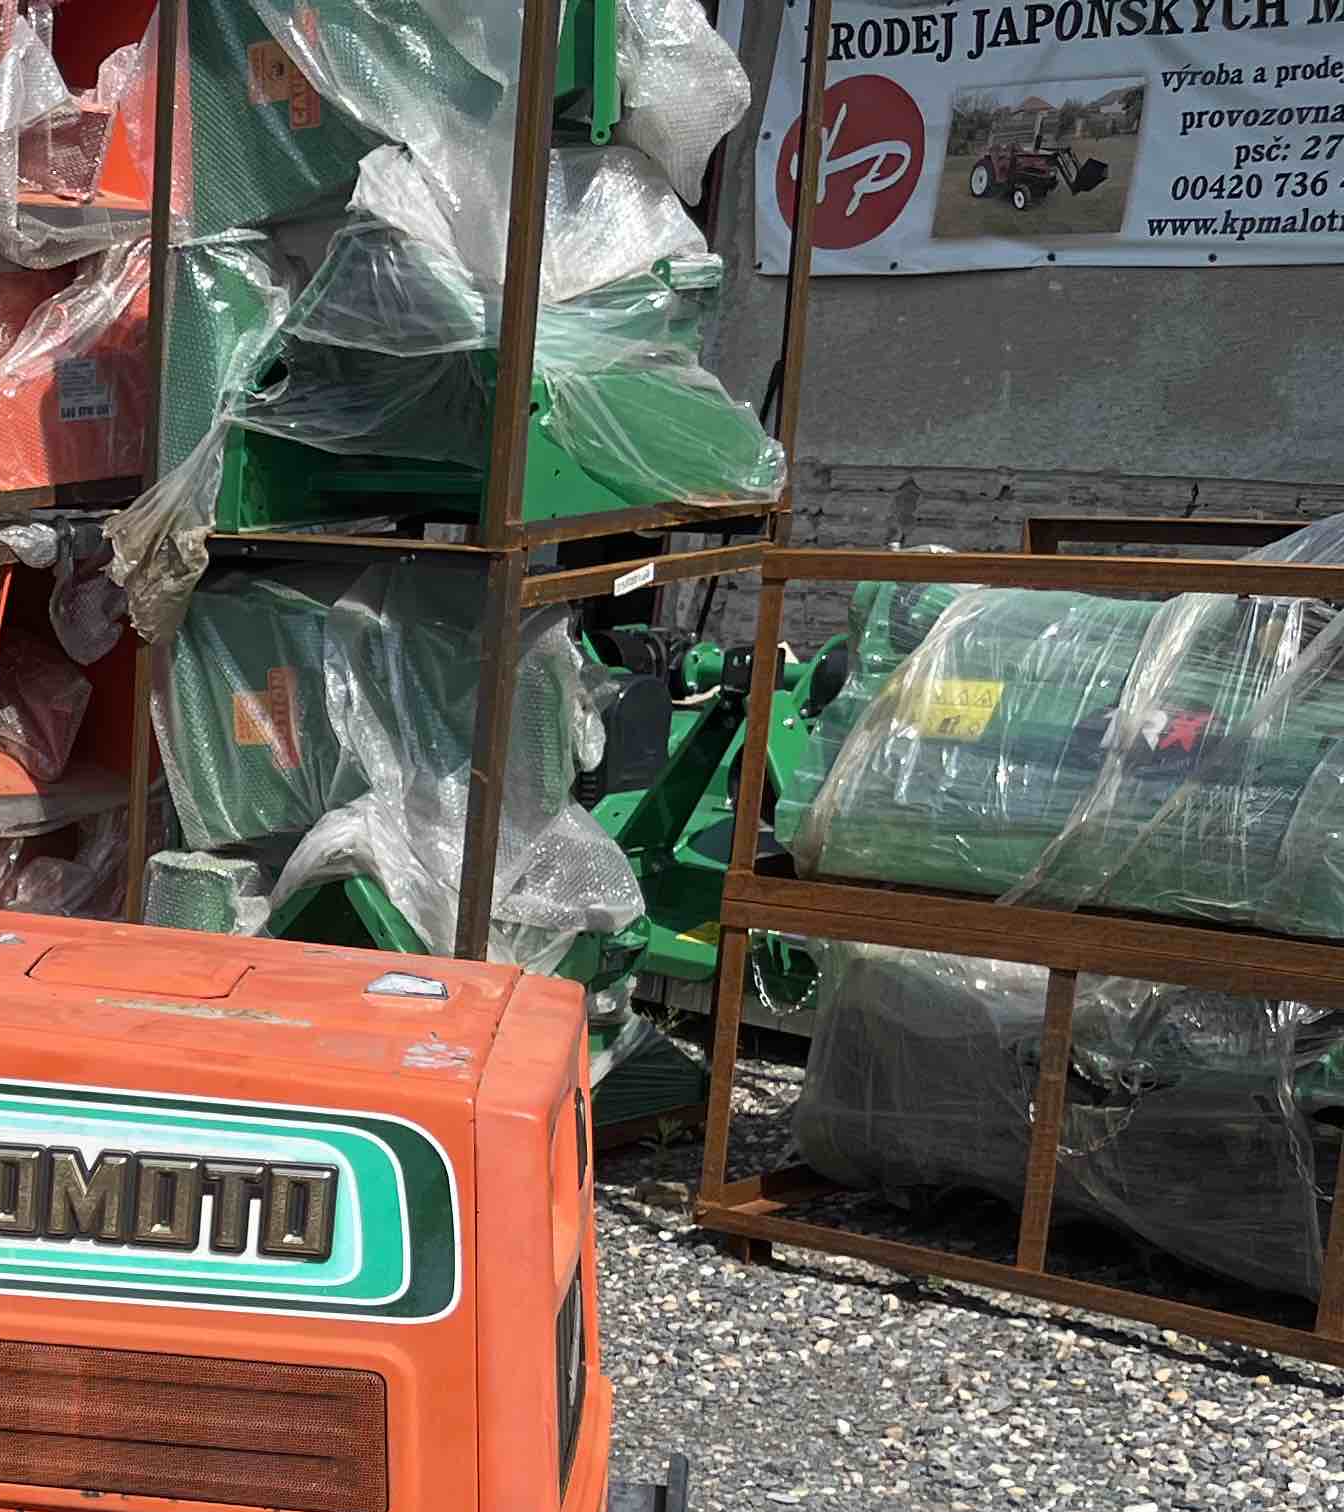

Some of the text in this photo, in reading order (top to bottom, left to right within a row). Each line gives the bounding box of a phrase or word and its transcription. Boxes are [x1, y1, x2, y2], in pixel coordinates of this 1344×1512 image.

[1161, 54, 1344, 93] výroba a prode
[1234, 135, 1291, 170] psč:
[1171, 170, 1329, 200] 00420 736
